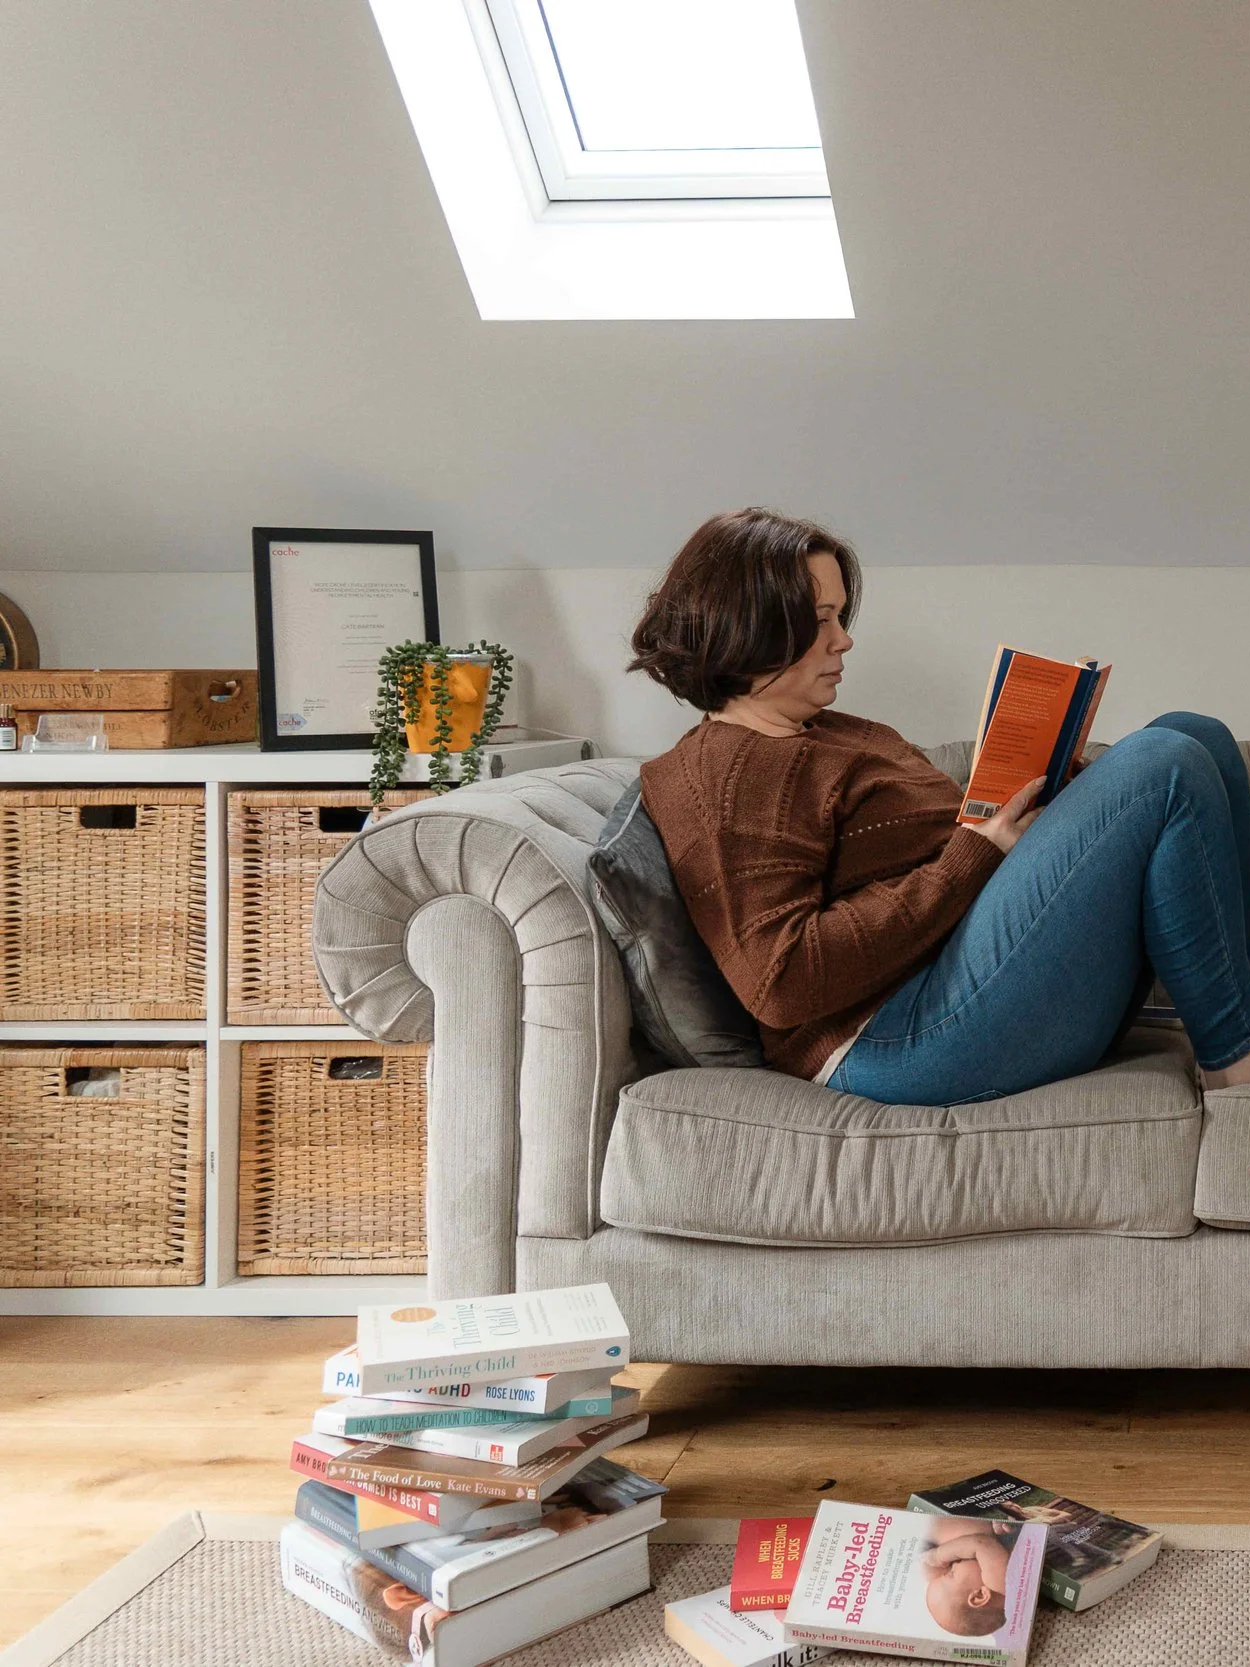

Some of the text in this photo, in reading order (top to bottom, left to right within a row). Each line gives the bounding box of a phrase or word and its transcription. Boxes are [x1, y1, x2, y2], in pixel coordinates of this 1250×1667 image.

[272, 547, 300, 556] cache
[0, 684, 113, 699] ENEZER NEWBY
[279, 717, 301, 726] cache
[384, 1356, 516, 1384] The Thriving Child
[486, 1386, 508, 1400] ROSE
[508, 1388, 536, 1402] LYONS
[356, 1420, 375, 1434] HOW
[379, 1418, 388, 1432] TO
[391, 1416, 414, 1431] TEACH
[416, 1412, 460, 1429] MEDITATION
[463, 1411, 472, 1424] TO
[474, 1409, 507, 1424] CHILDREN
[296, 1452, 310, 1467] AMY
[350, 1467, 506, 1497] The Food of Love Kate Evans
[388, 1486, 422, 1511] IS BEST
[943, 1482, 1016, 1509] BREASTFEEDING
[975, 1485, 1032, 1510] UNCOVERED
[310, 1506, 418, 1582] BREASTFEEDING LACTATION
[758, 1540, 772, 1563] WHEN
[771, 1524, 788, 1580] BREASTFEEDING
[788, 1538, 800, 1561] SUCKS
[812, 1521, 844, 1607] TRACEY MURKETT
[827, 1522, 870, 1612] Baby-led
[846, 1514, 892, 1625] Breastfeeding
[294, 1564, 361, 1613] BREASTFEEDING
[742, 1594, 791, 1607] WHEN BR
[792, 1629, 916, 1653] Baby-led Breastfeeding
